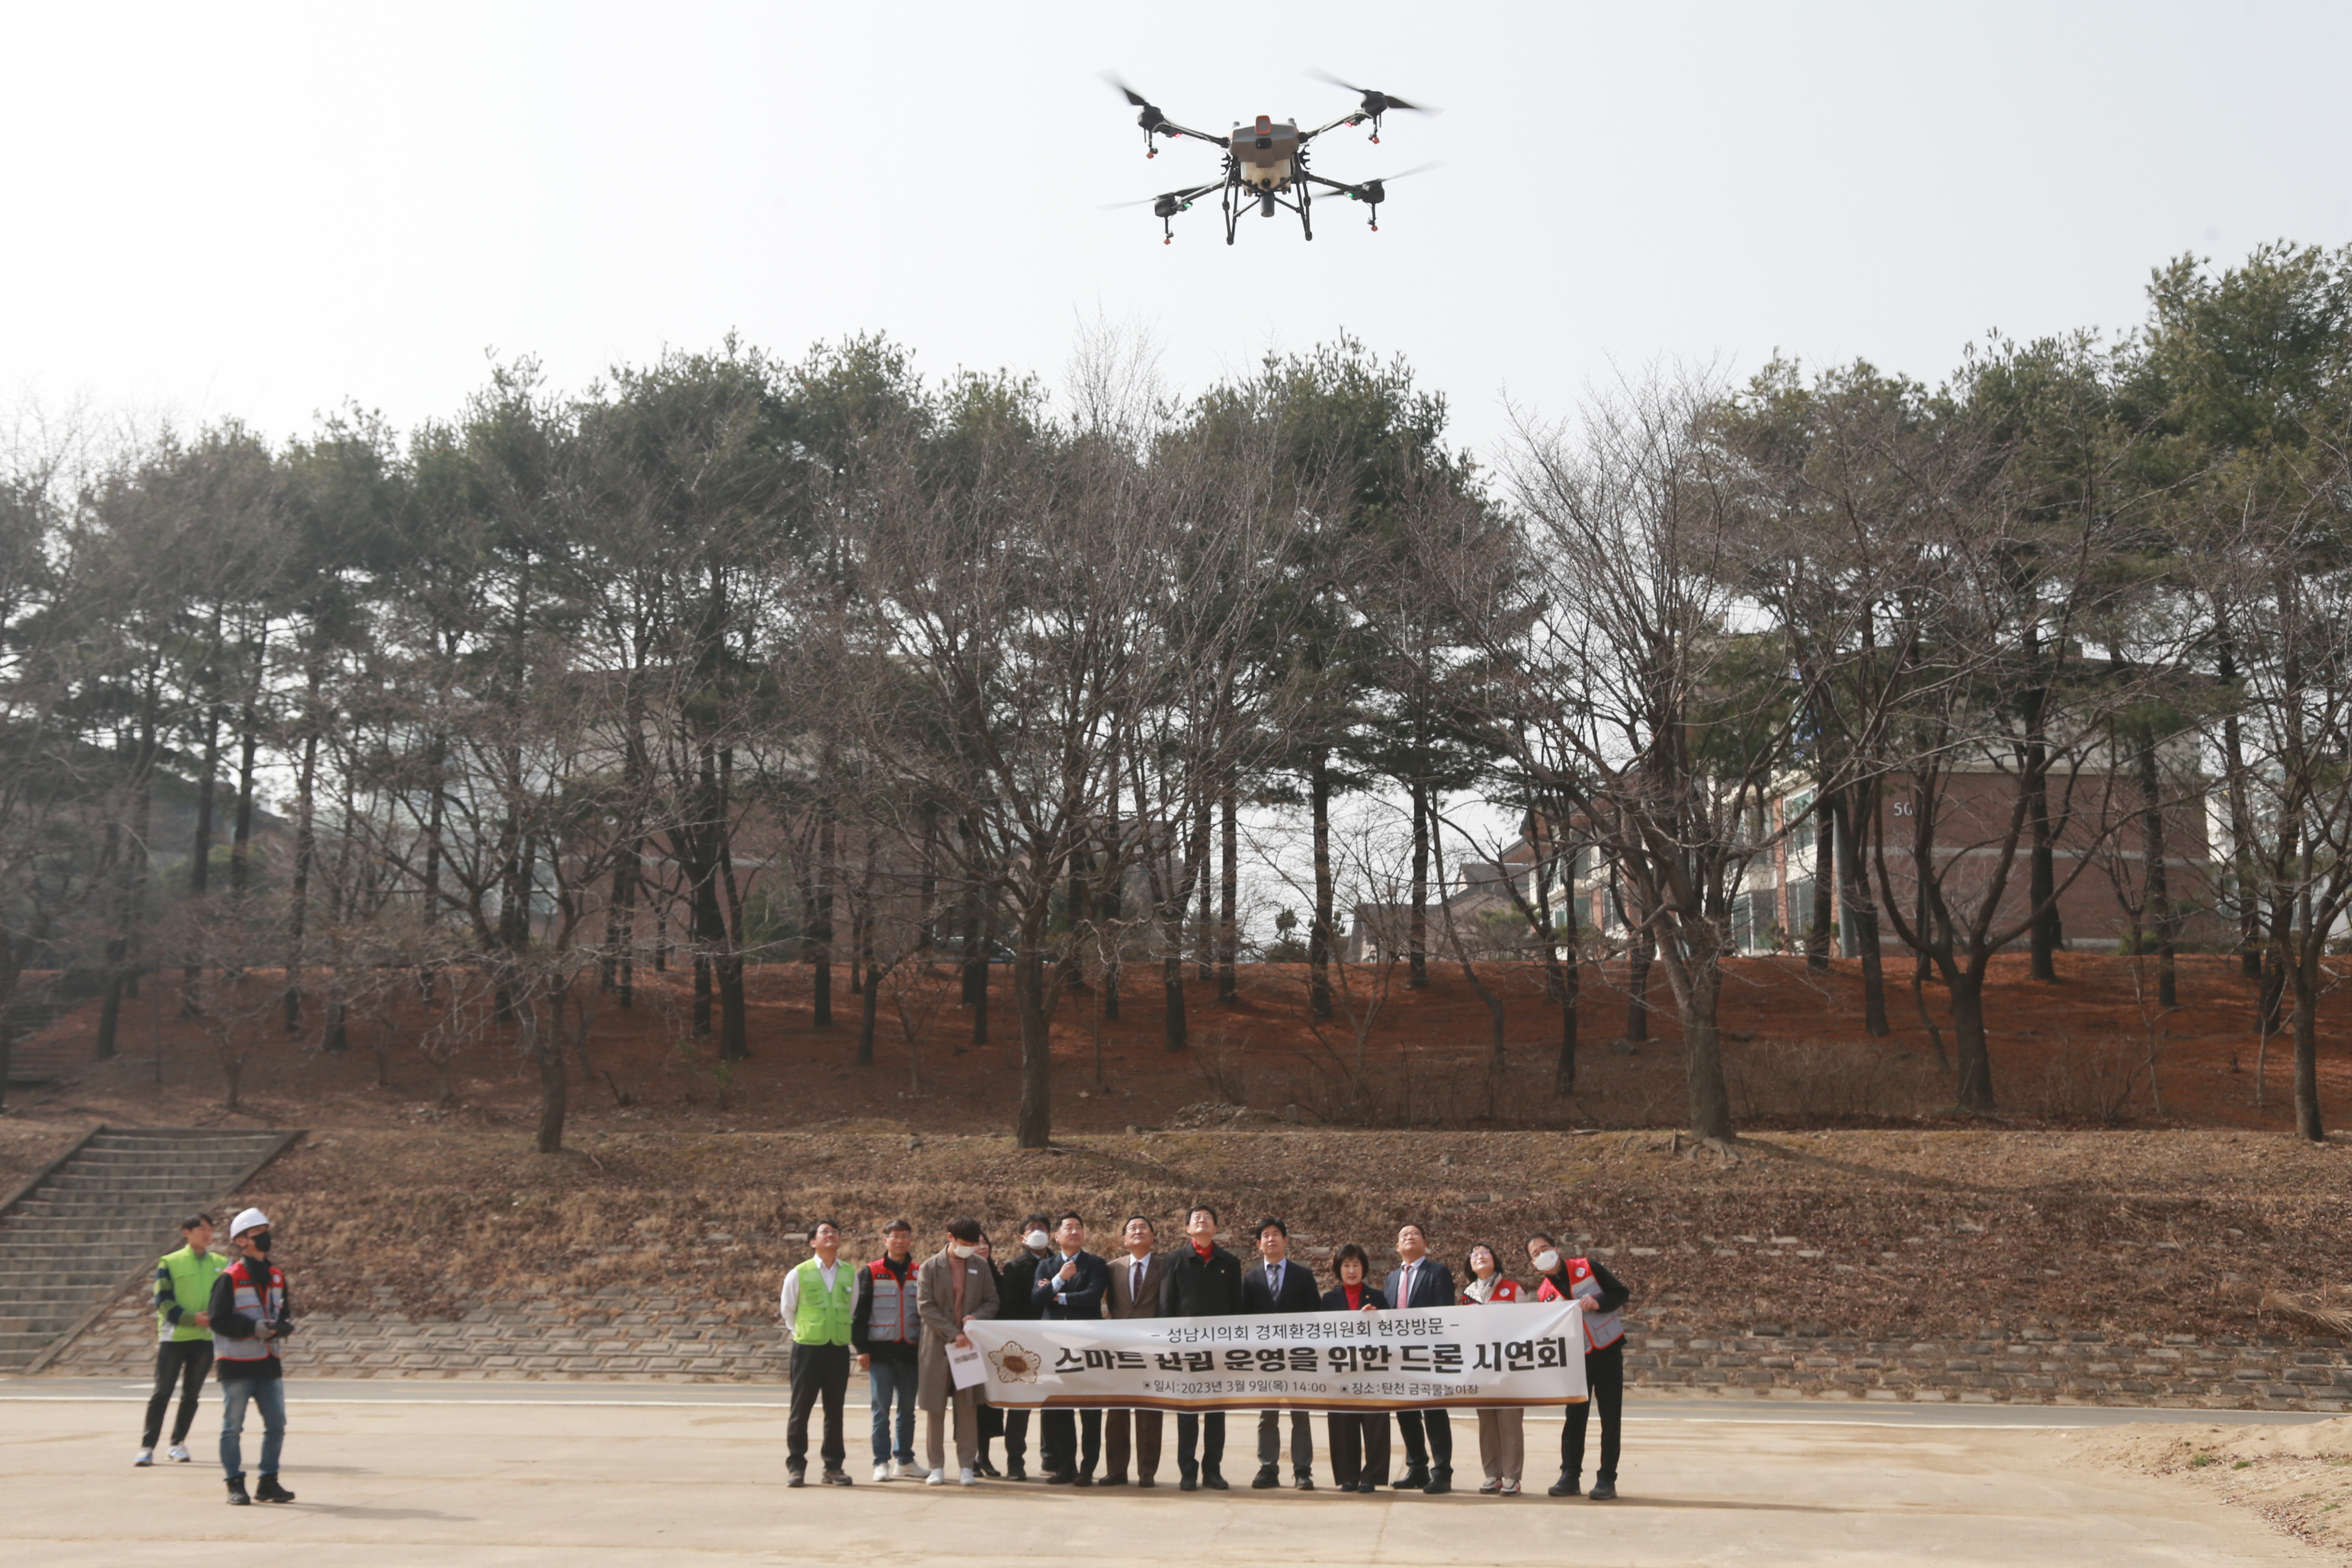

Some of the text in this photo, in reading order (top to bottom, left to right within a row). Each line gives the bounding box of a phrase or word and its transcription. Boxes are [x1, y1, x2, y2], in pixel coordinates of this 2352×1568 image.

[1167, 1317, 1444, 1343] 성남시의회 경제환경위원회 현장방문
[1055, 1348, 1147, 1373] 스마트
[1224, 1346, 1319, 1373] 운영을
[1328, 1345, 1392, 1373] 위한
[1399, 1343, 1463, 1373] 드론
[1472, 1337, 1567, 1372] 시연회
[1154, 1381, 1327, 1394] 일시:2023년 3월 9일(목) 14:00
[1351, 1382, 1479, 1397] 장소:탄천 금곡물놀이장
